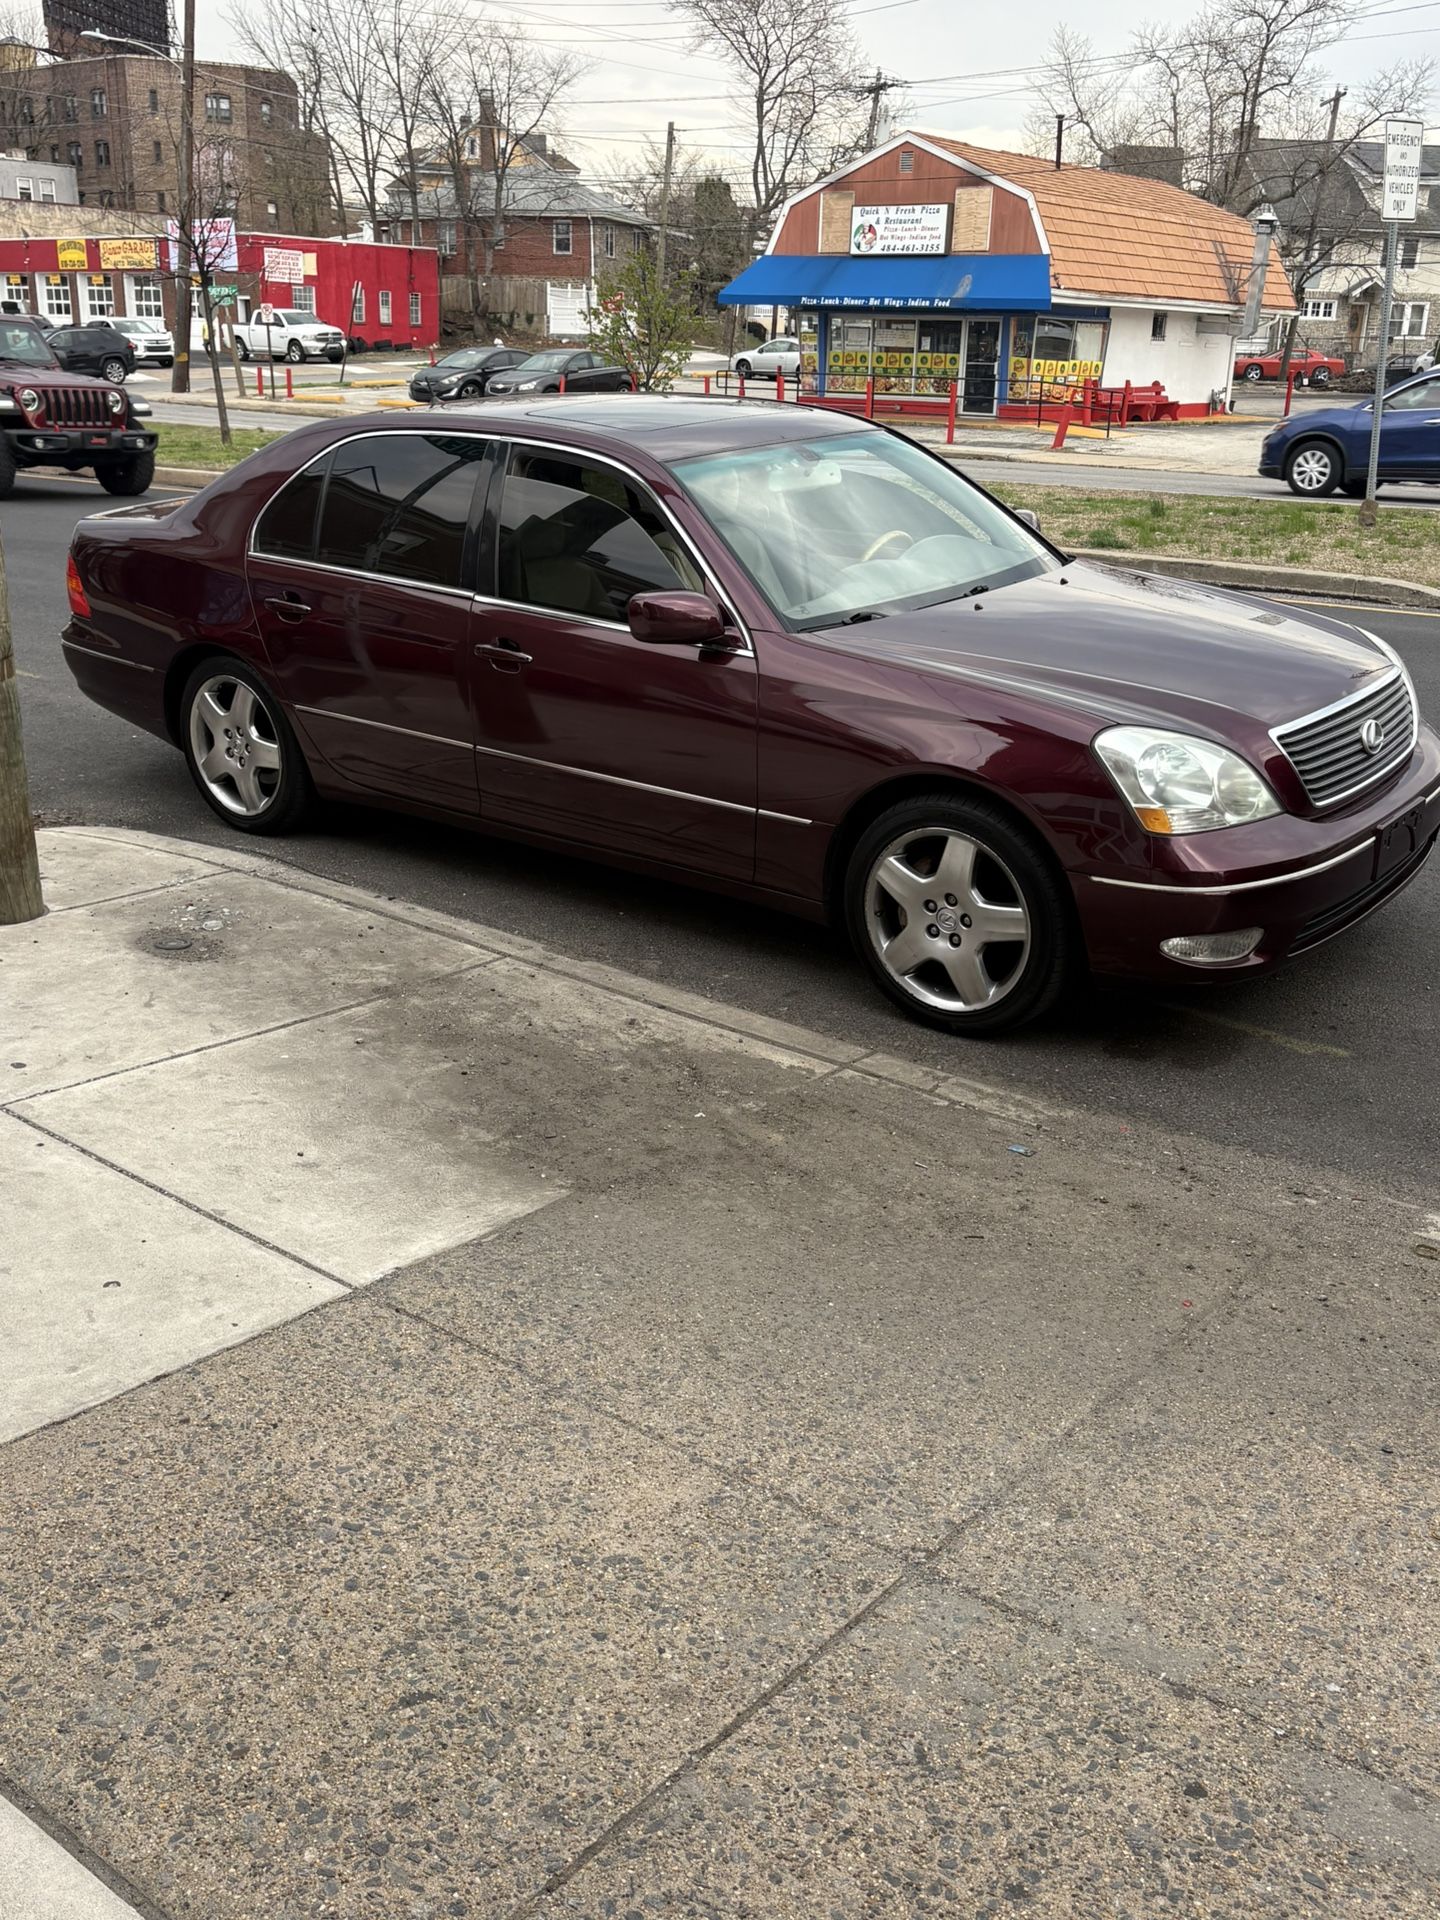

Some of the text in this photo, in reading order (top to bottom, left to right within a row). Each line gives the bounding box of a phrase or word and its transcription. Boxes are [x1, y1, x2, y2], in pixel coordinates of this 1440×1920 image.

[1388, 133, 1420, 147] EMERGENCY
[1387, 165, 1419, 177] AUTHORIZED
[1389, 182, 1414, 194] VEHICLES
[1393, 199, 1406, 211] ONLY
[860, 207, 880, 217] Quick
[895, 207, 916, 215] Fresh
[920, 206, 941, 214] Pizza
[875, 217, 922, 225] & Restaurant
[122, 240, 154, 254] GARAGE
[880, 243, 941, 252] 484-461-3155
[933, 298, 951, 307] Food
